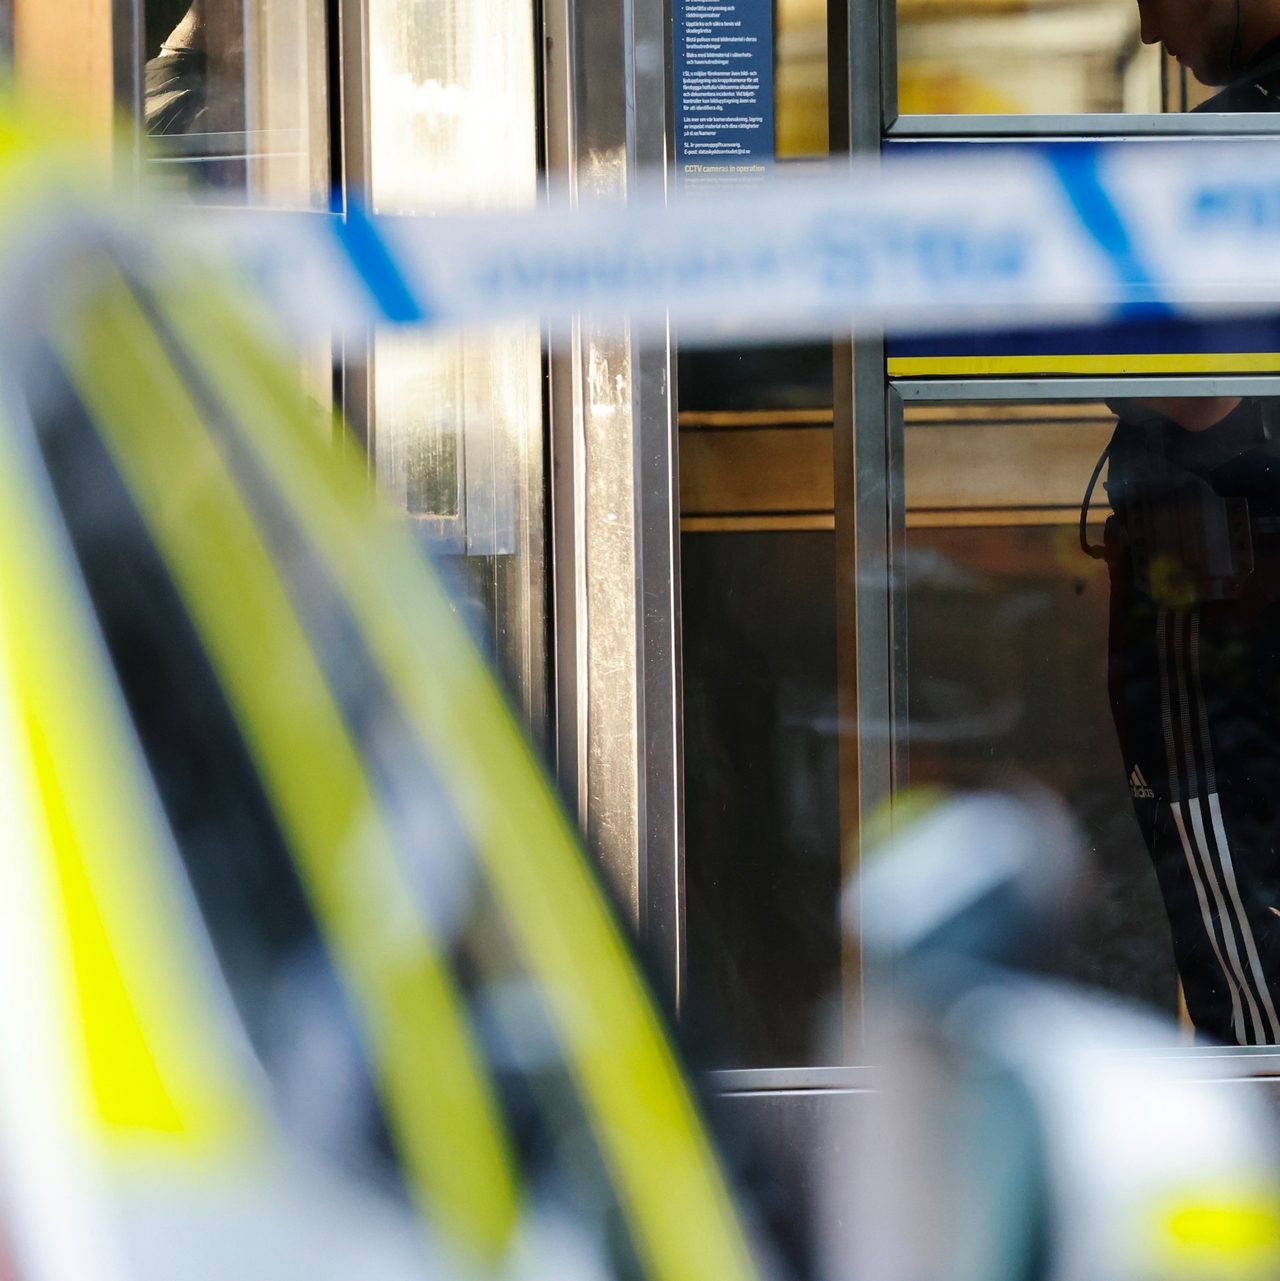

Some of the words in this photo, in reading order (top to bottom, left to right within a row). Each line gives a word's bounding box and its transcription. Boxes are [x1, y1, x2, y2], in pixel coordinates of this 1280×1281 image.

[684, 164, 702, 173] CCTV
[702, 164, 729, 173] cameras
[729, 164, 736, 173] in
[736, 164, 765, 173] operation
